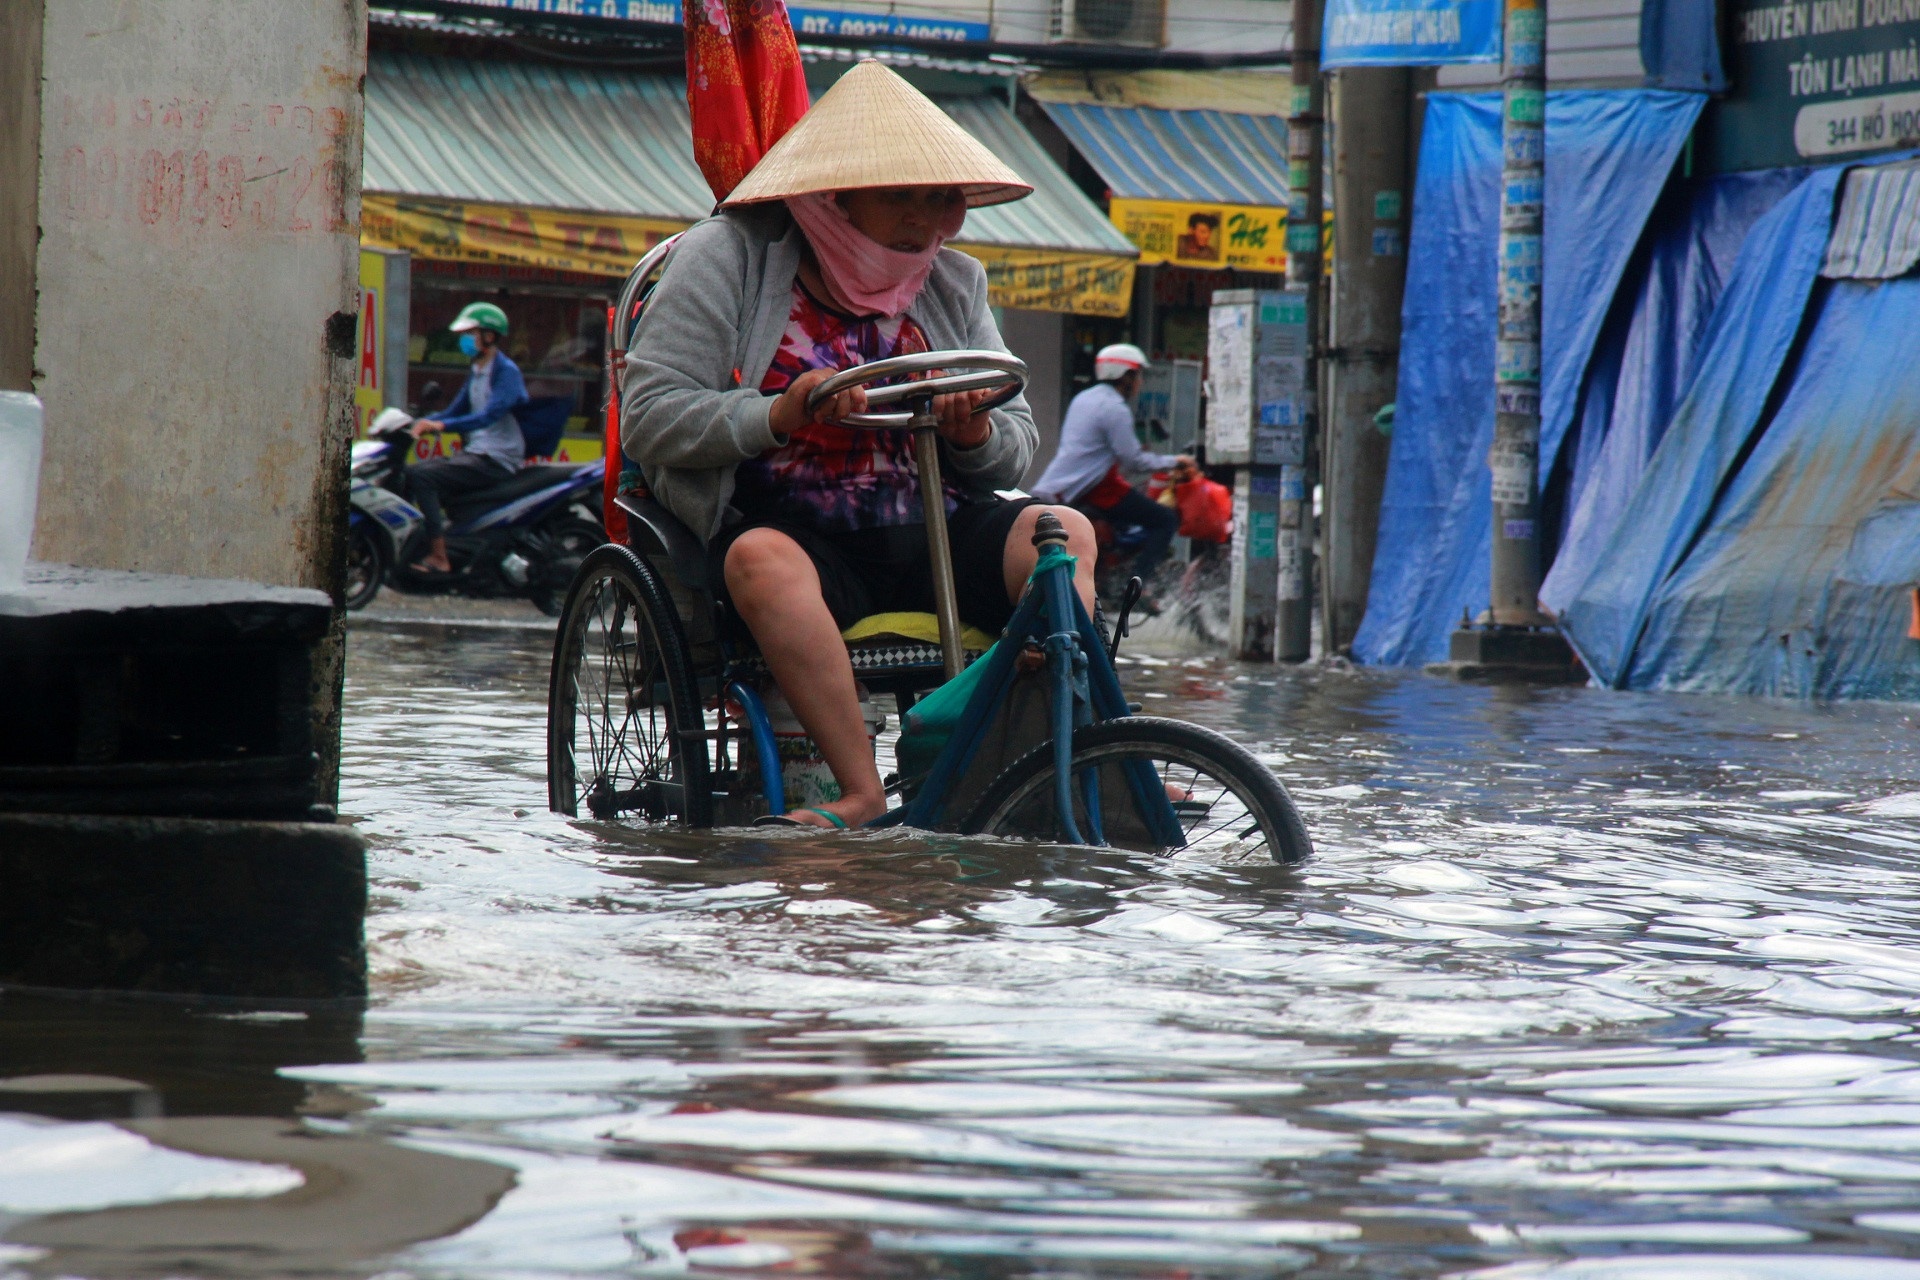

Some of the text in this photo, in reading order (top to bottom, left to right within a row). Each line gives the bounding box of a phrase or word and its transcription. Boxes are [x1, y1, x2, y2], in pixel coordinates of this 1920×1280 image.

[628, 0, 676, 24] BÌNH
[1811, 0, 1858, 34] KINH
[1862, 0, 1920, 27] DOAN
[1788, 51, 1829, 96] TÔN
[1832, 51, 1885, 96] LẠNH
[1827, 116, 1857, 146] 344
